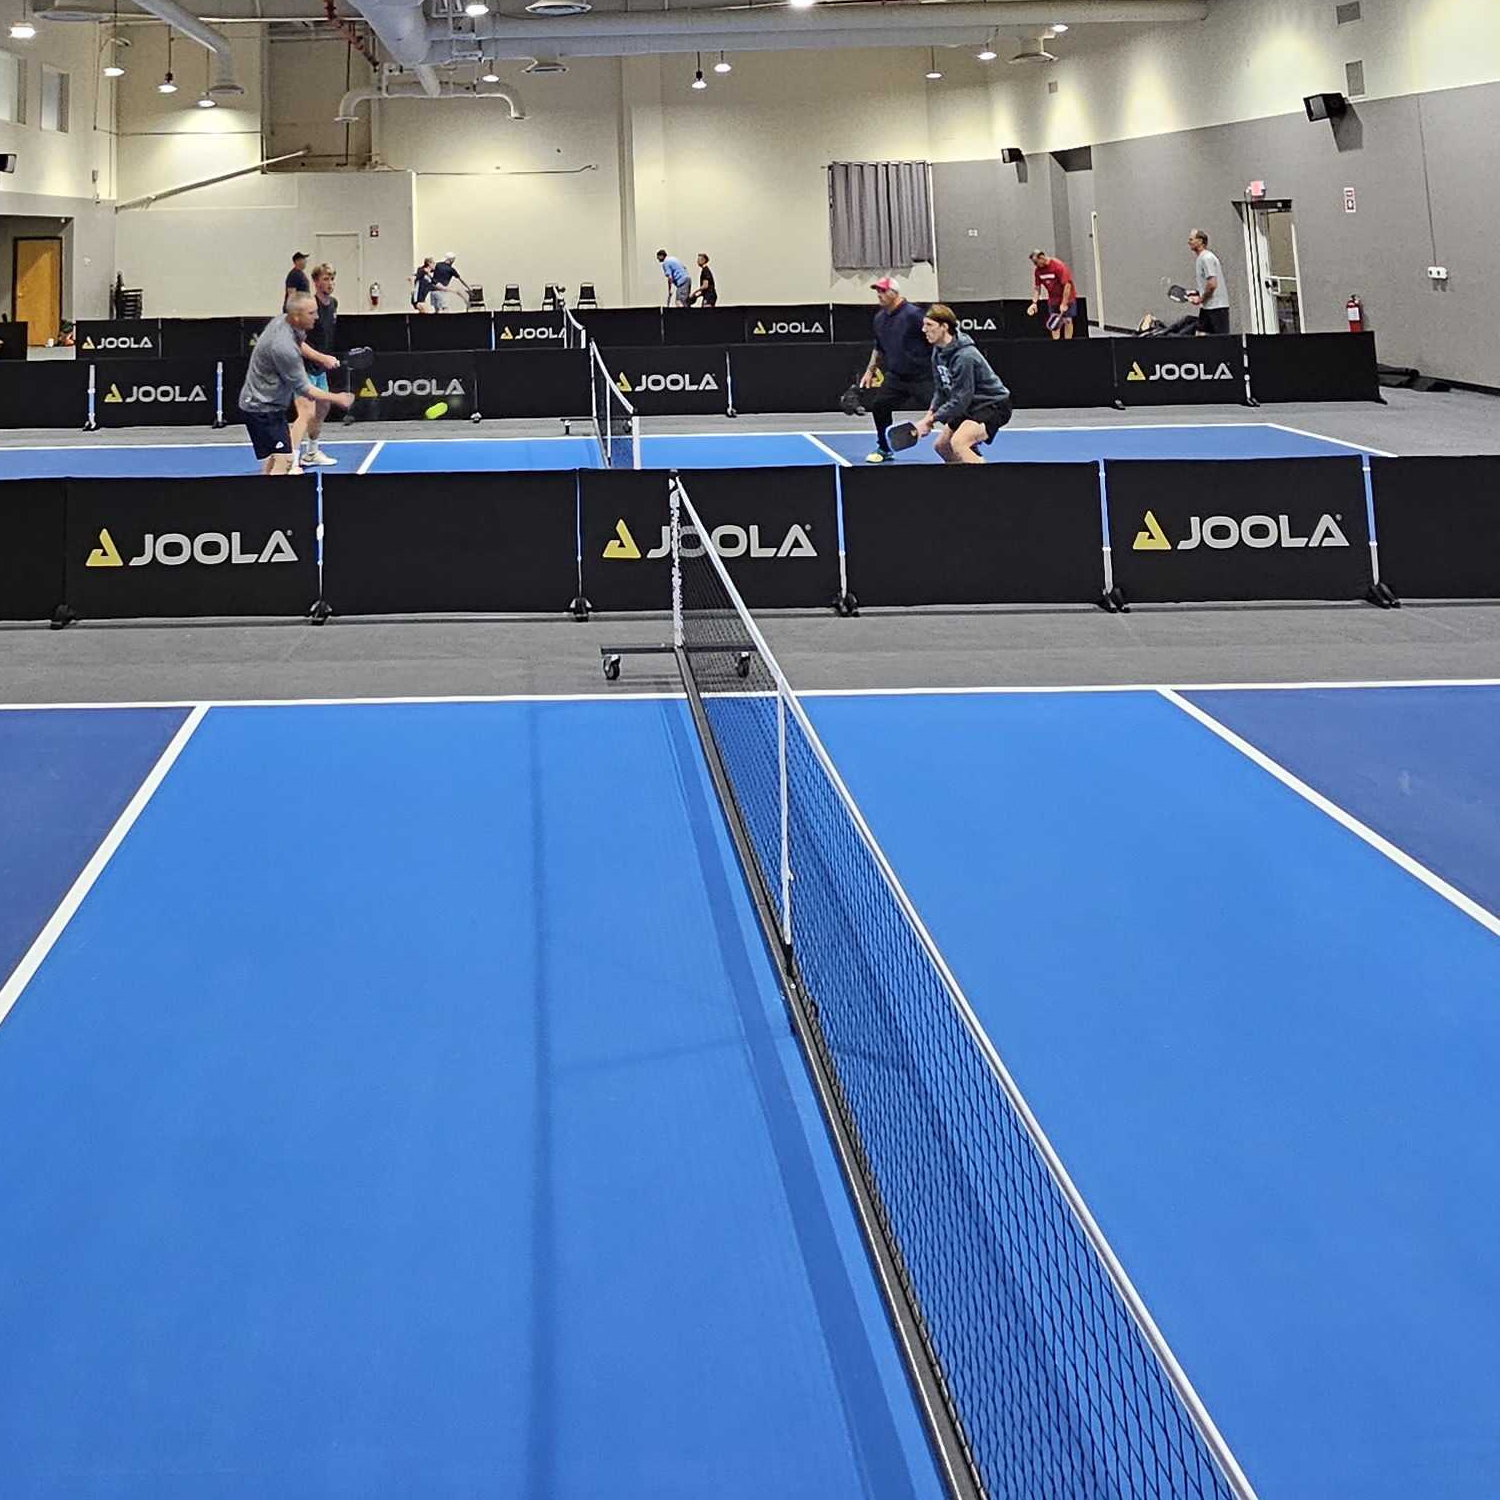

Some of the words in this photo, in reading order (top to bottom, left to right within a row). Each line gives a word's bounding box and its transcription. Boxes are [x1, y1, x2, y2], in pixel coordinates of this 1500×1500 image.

[768, 322, 825, 334] JOOLA
[960, 318, 997, 330] OLA
[96, 336, 153, 350] JOOLA
[1148, 362, 1234, 381] JOOLA
[380, 378, 465, 397] JOOLA
[634, 373, 719, 392] JOOLA
[125, 384, 207, 403] JOOLA
[1177, 514, 1350, 550] JOOLA
[128, 529, 299, 566] JOOLA
